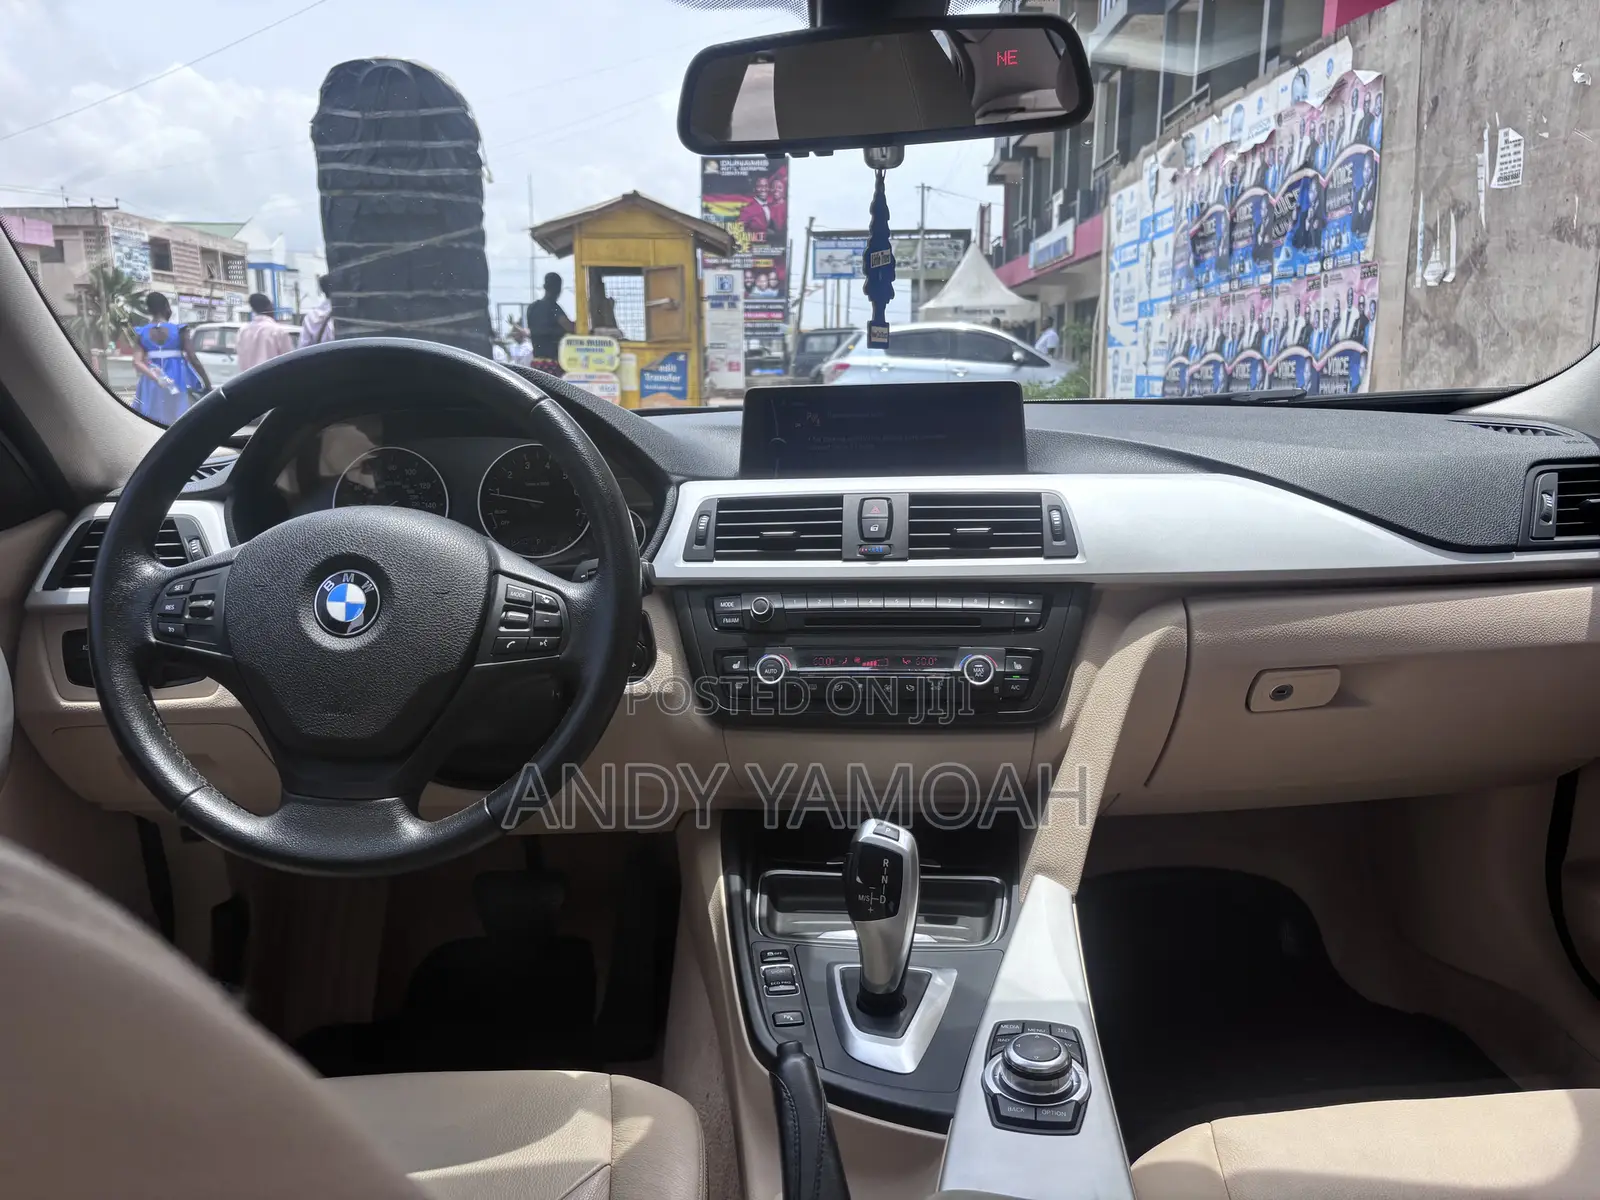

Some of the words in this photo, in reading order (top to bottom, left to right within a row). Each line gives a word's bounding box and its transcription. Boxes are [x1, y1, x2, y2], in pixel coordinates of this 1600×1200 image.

[996, 49, 1018, 66] NE
[1328, 356, 1350, 376] VOICE
[323, 572, 375, 594] BMW
[882, 858, 889, 867] R
[881, 875, 888, 884] N
[880, 895, 886, 904] D
